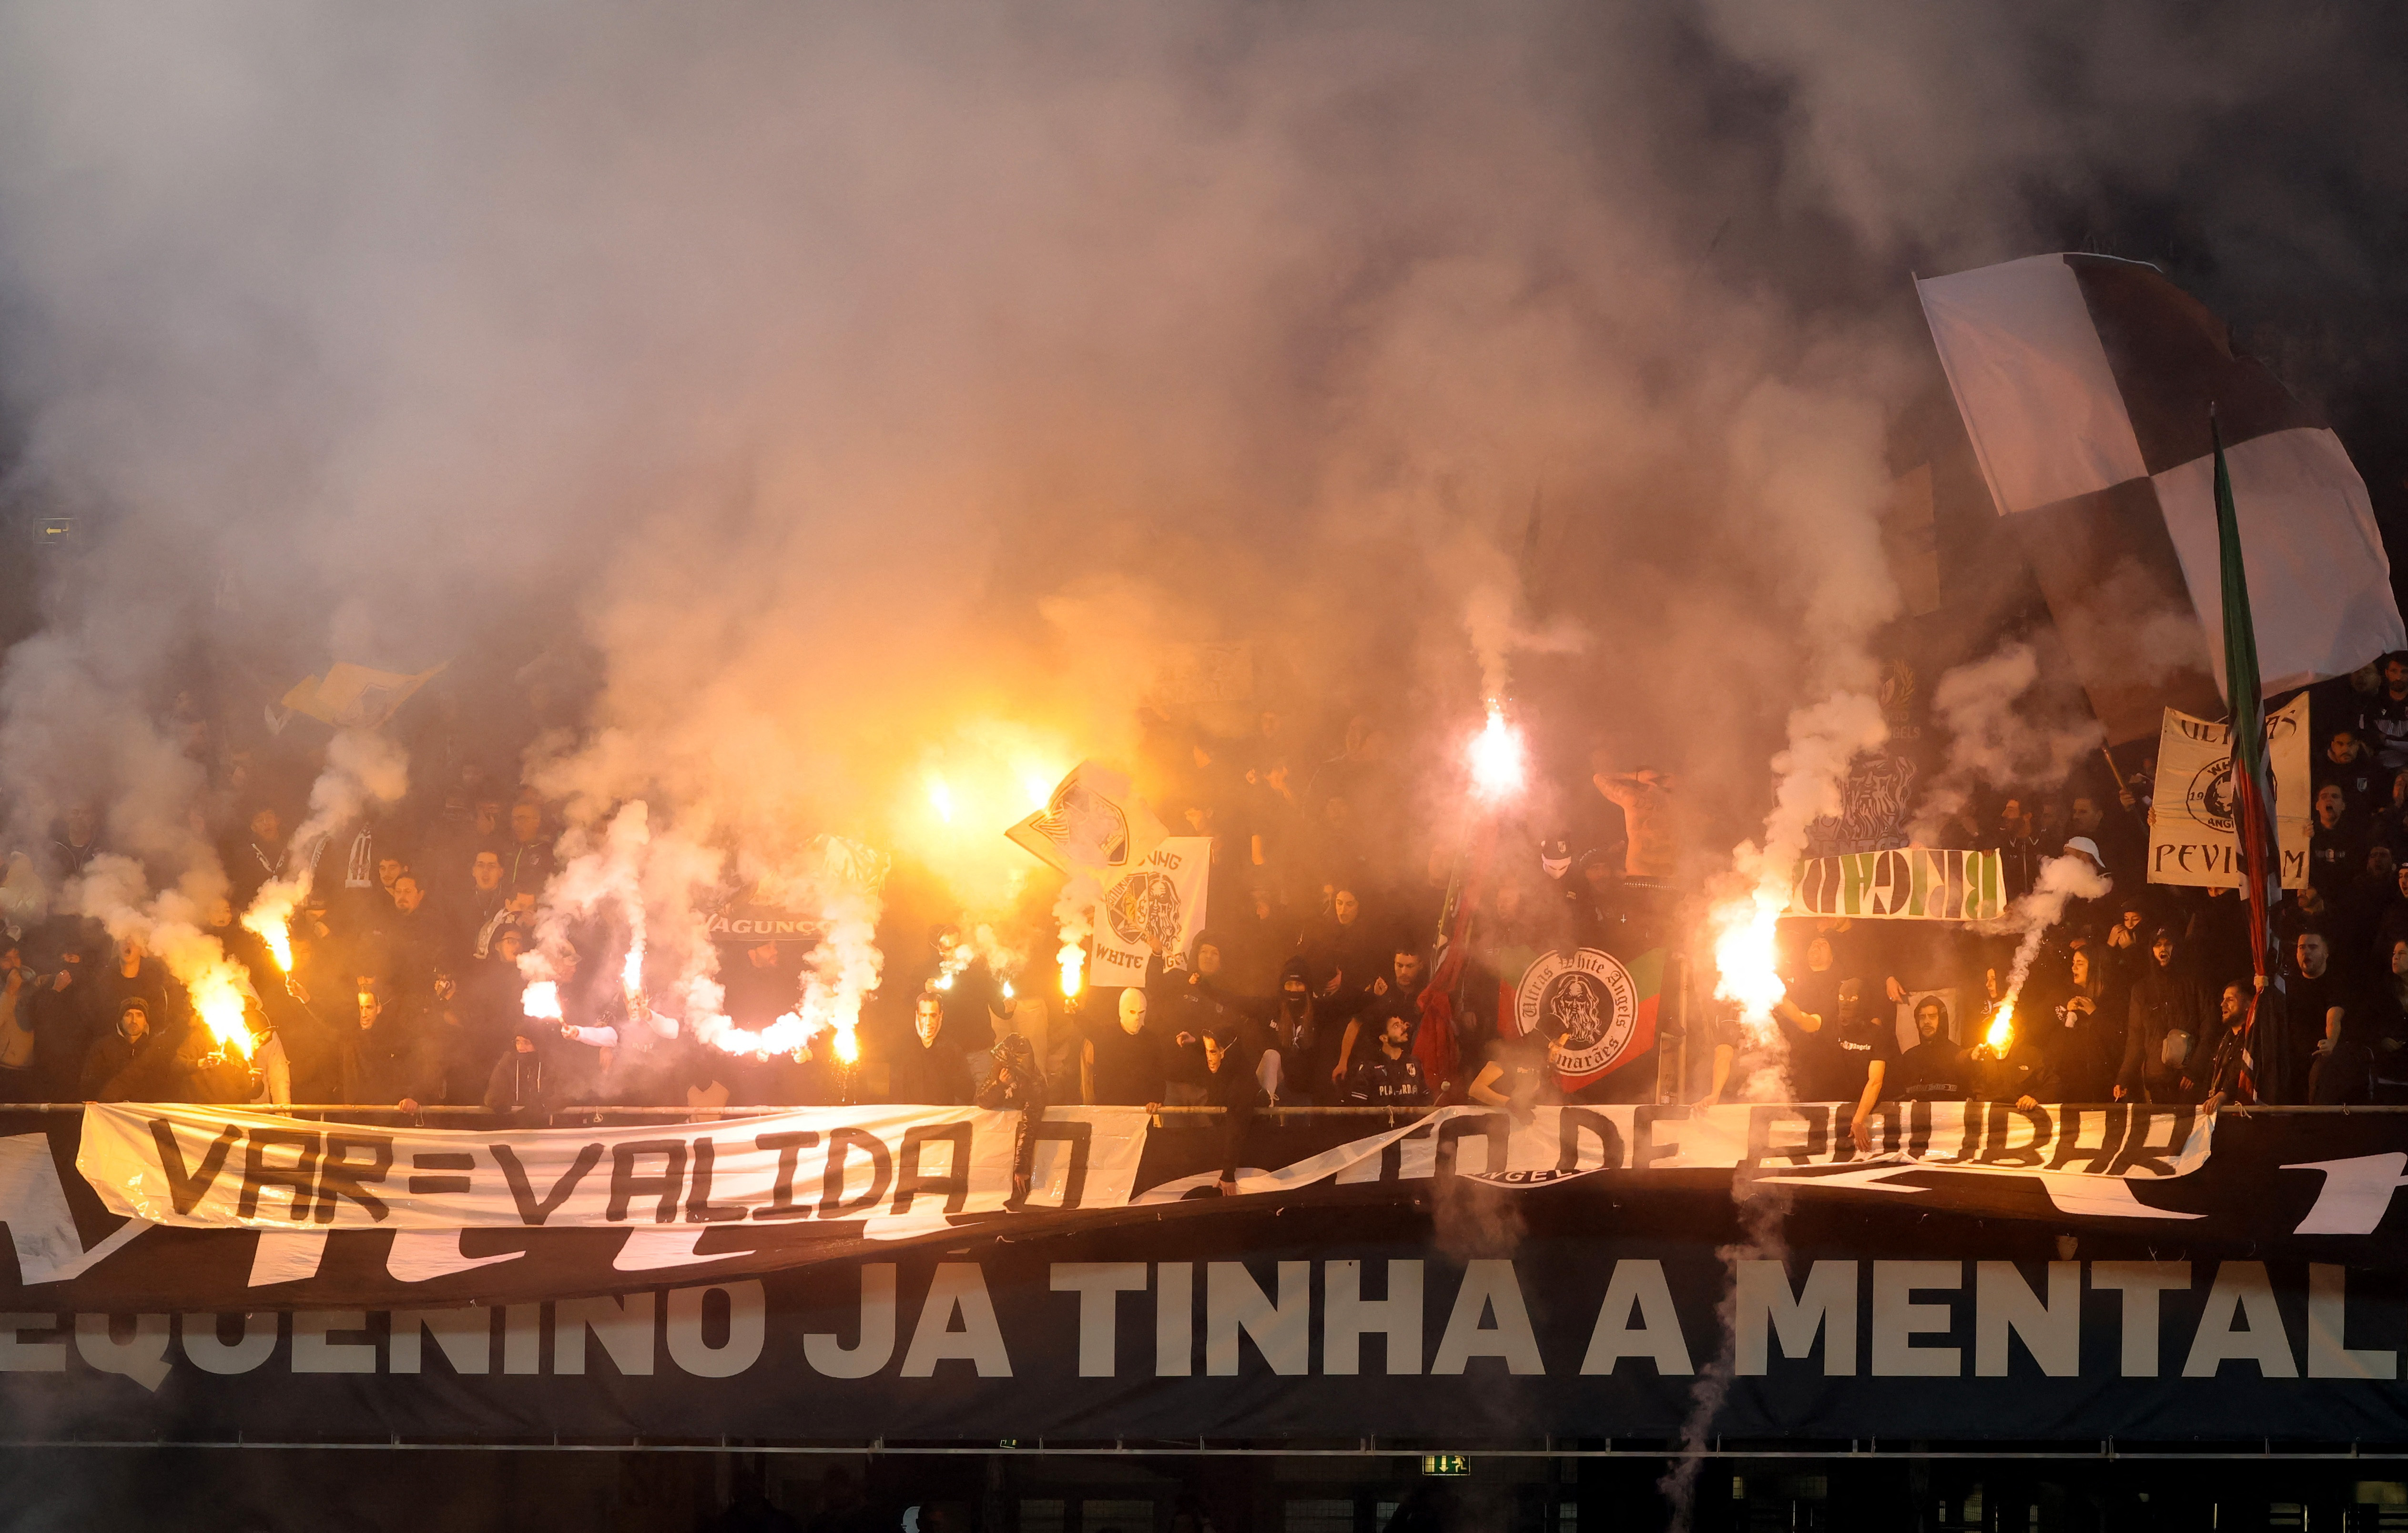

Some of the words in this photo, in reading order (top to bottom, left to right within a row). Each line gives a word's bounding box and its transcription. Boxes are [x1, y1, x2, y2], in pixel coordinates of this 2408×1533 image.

[2182, 710, 2297, 744] ULAS
[2207, 817, 2234, 829] ANG
[2155, 844, 2305, 878] PEVIM
[1796, 850, 1997, 919] BRIGAD
[1096, 943, 1143, 968] WHITE
[1522, 965, 1554, 1018] Ultras
[1558, 954, 1605, 974] White
[1605, 970, 1630, 1028] Angels
[1556, 1036, 1620, 1069] marães
[803, 1248, 1013, 1379] JÁ
[1050, 1259, 1546, 1377] TINHA
[1579, 1259, 1695, 1376] A
